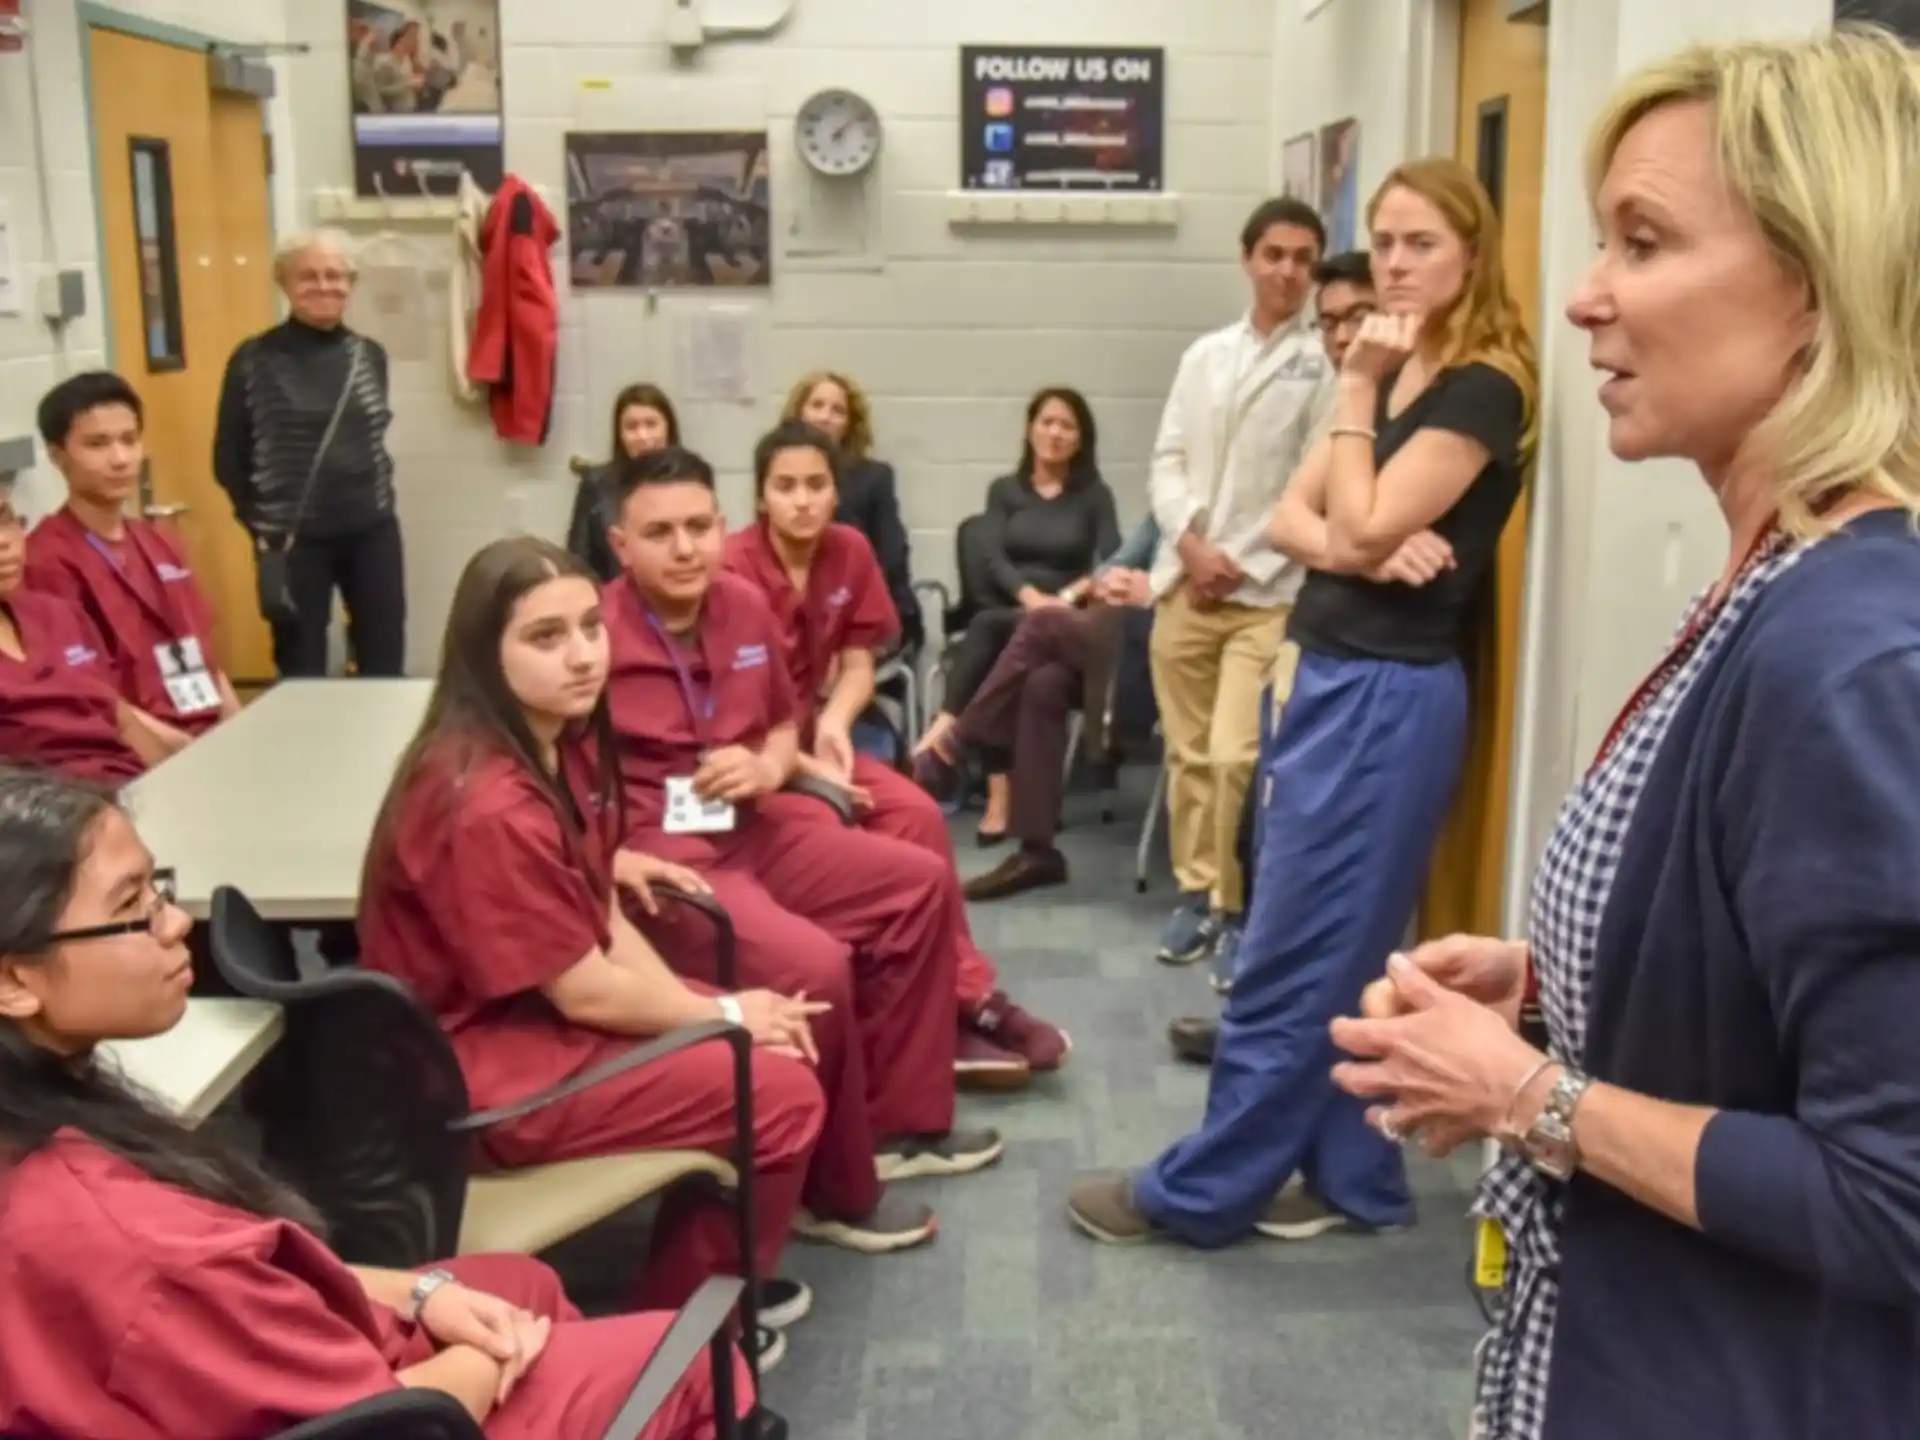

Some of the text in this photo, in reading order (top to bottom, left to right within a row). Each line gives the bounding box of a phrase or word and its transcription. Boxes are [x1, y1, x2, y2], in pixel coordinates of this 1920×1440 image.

[975, 56, 1152, 82] FOLLOW US ON
